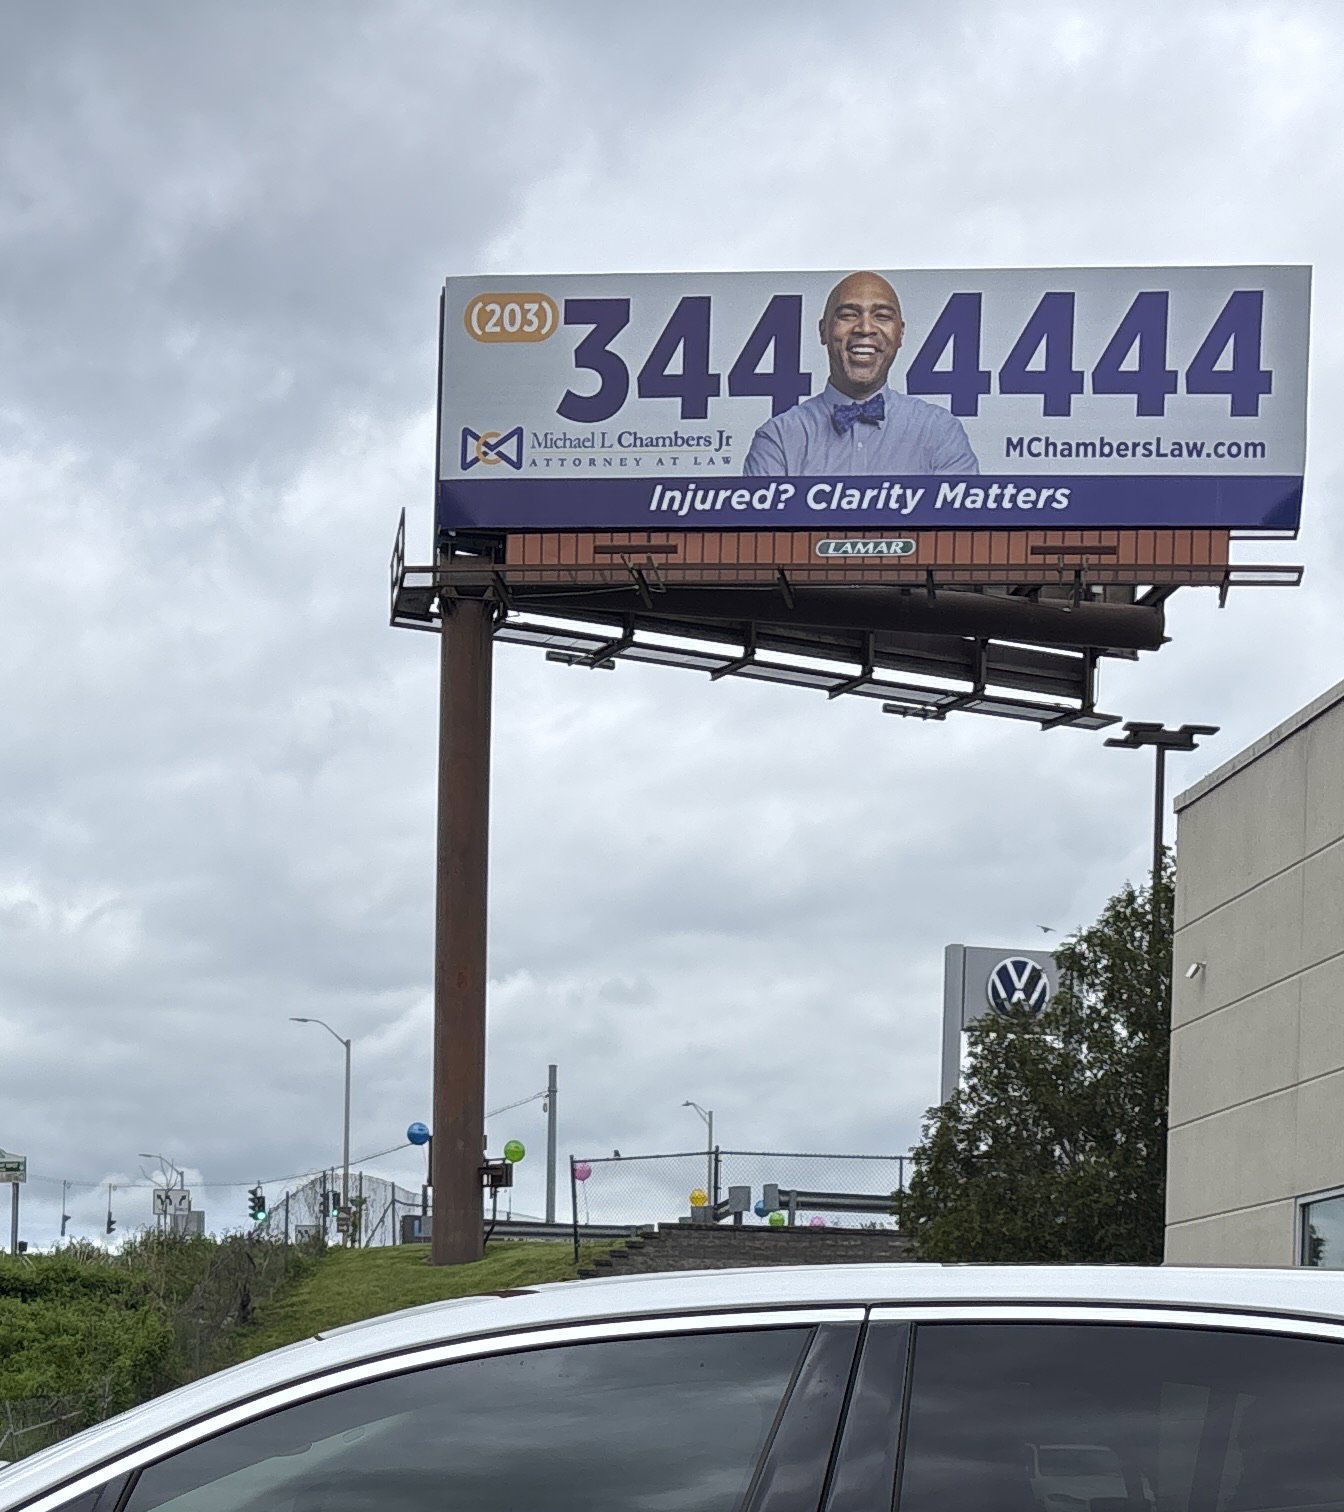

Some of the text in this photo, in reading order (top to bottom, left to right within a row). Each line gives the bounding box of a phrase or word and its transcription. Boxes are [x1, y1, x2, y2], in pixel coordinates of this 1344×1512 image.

[471, 290, 1273, 423] (203) 344 4444
[530, 429, 733, 452] Michael L Chambers Jr
[1004, 435, 1267, 459] MChambersLaw.com
[529, 455, 733, 468] ATTORNEY AT LAW
[649, 482, 1072, 516] Injured? Clarity Matters
[827, 540, 905, 555] LAMAR
